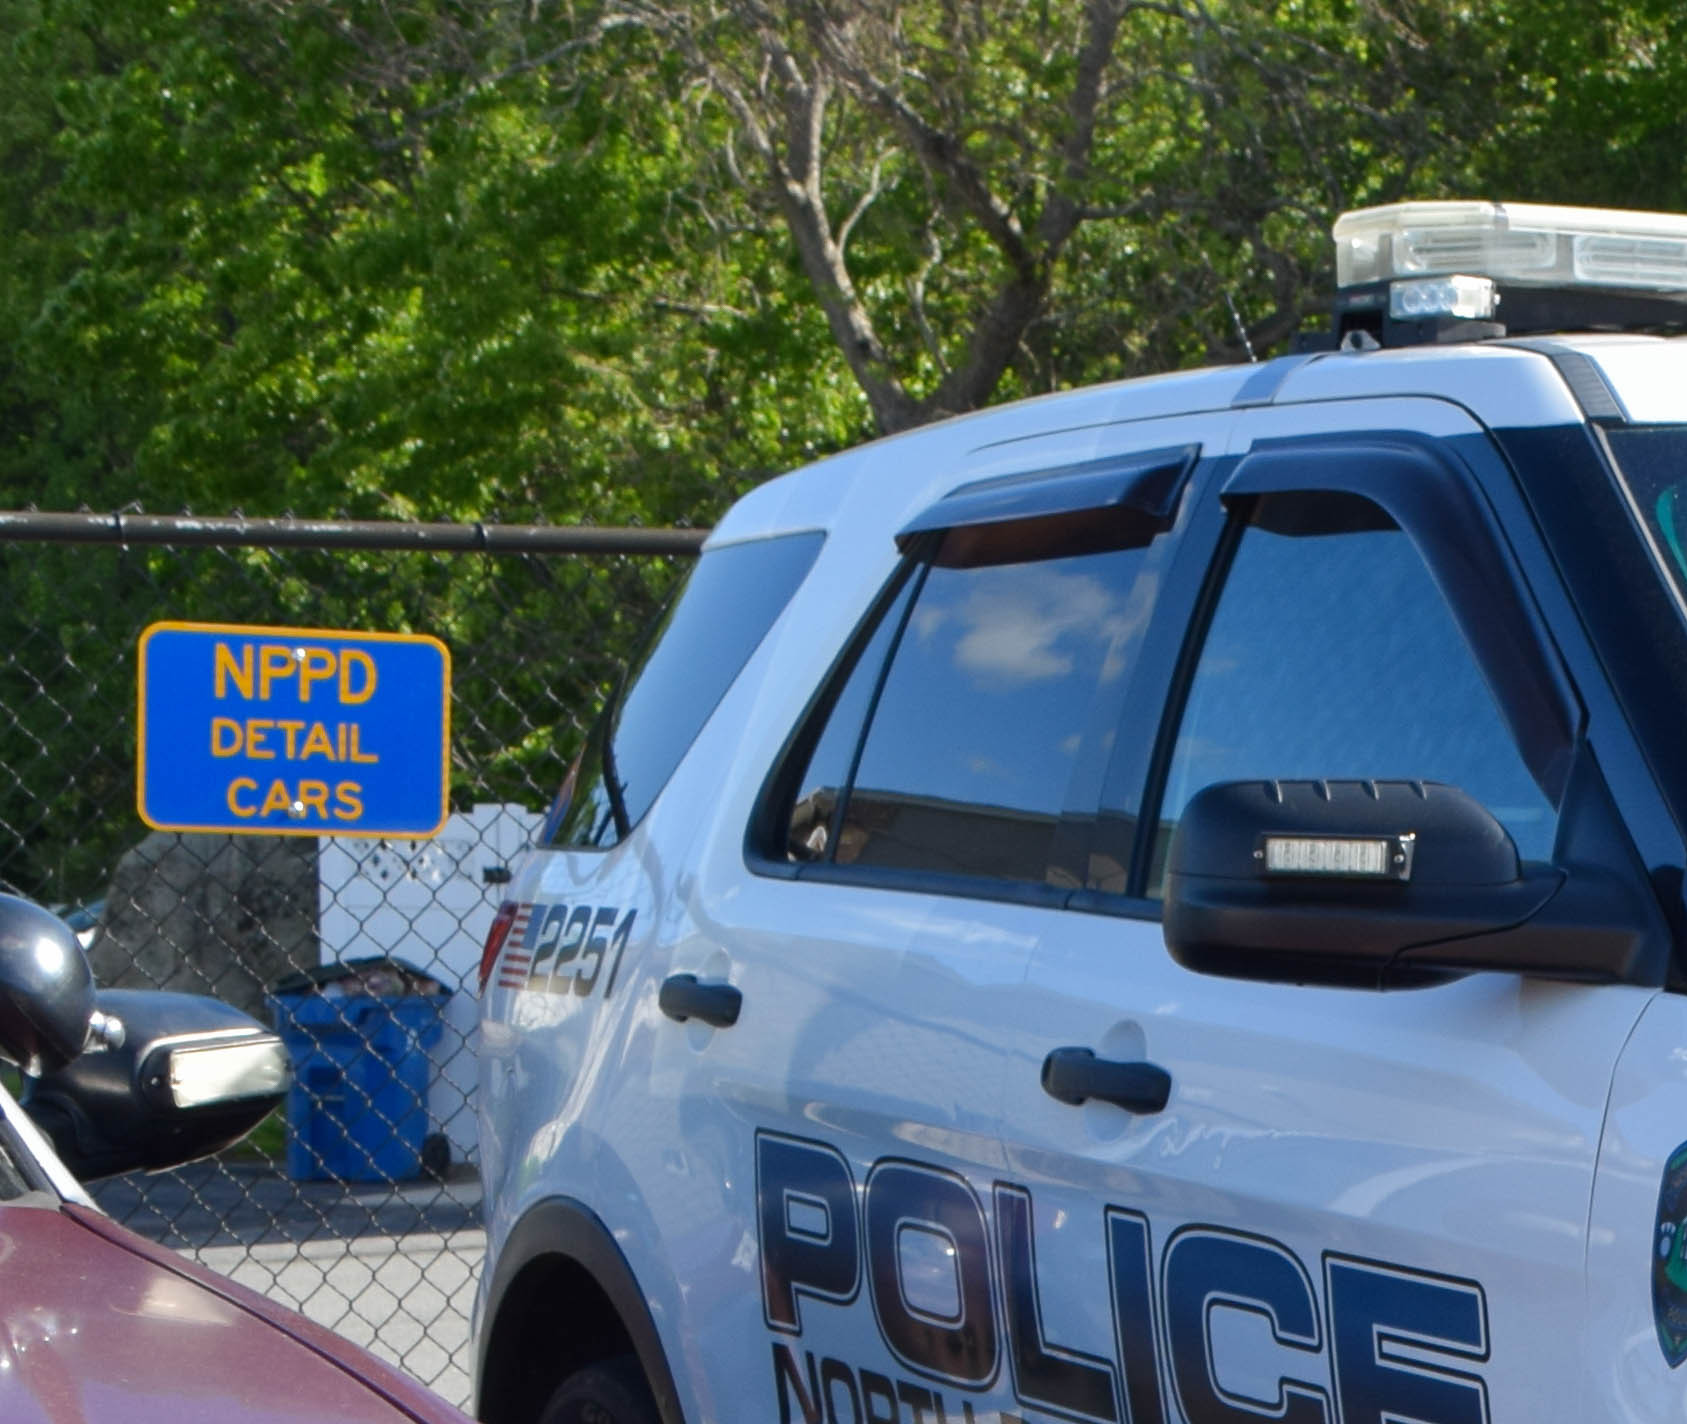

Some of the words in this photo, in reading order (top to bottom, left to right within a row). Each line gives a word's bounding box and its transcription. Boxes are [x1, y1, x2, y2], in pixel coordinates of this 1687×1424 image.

[214, 643, 378, 705] NPPD
[211, 717, 379, 763] DETAIL
[226, 777, 364, 821] CARS
[526, 902, 638, 1000] 2251
